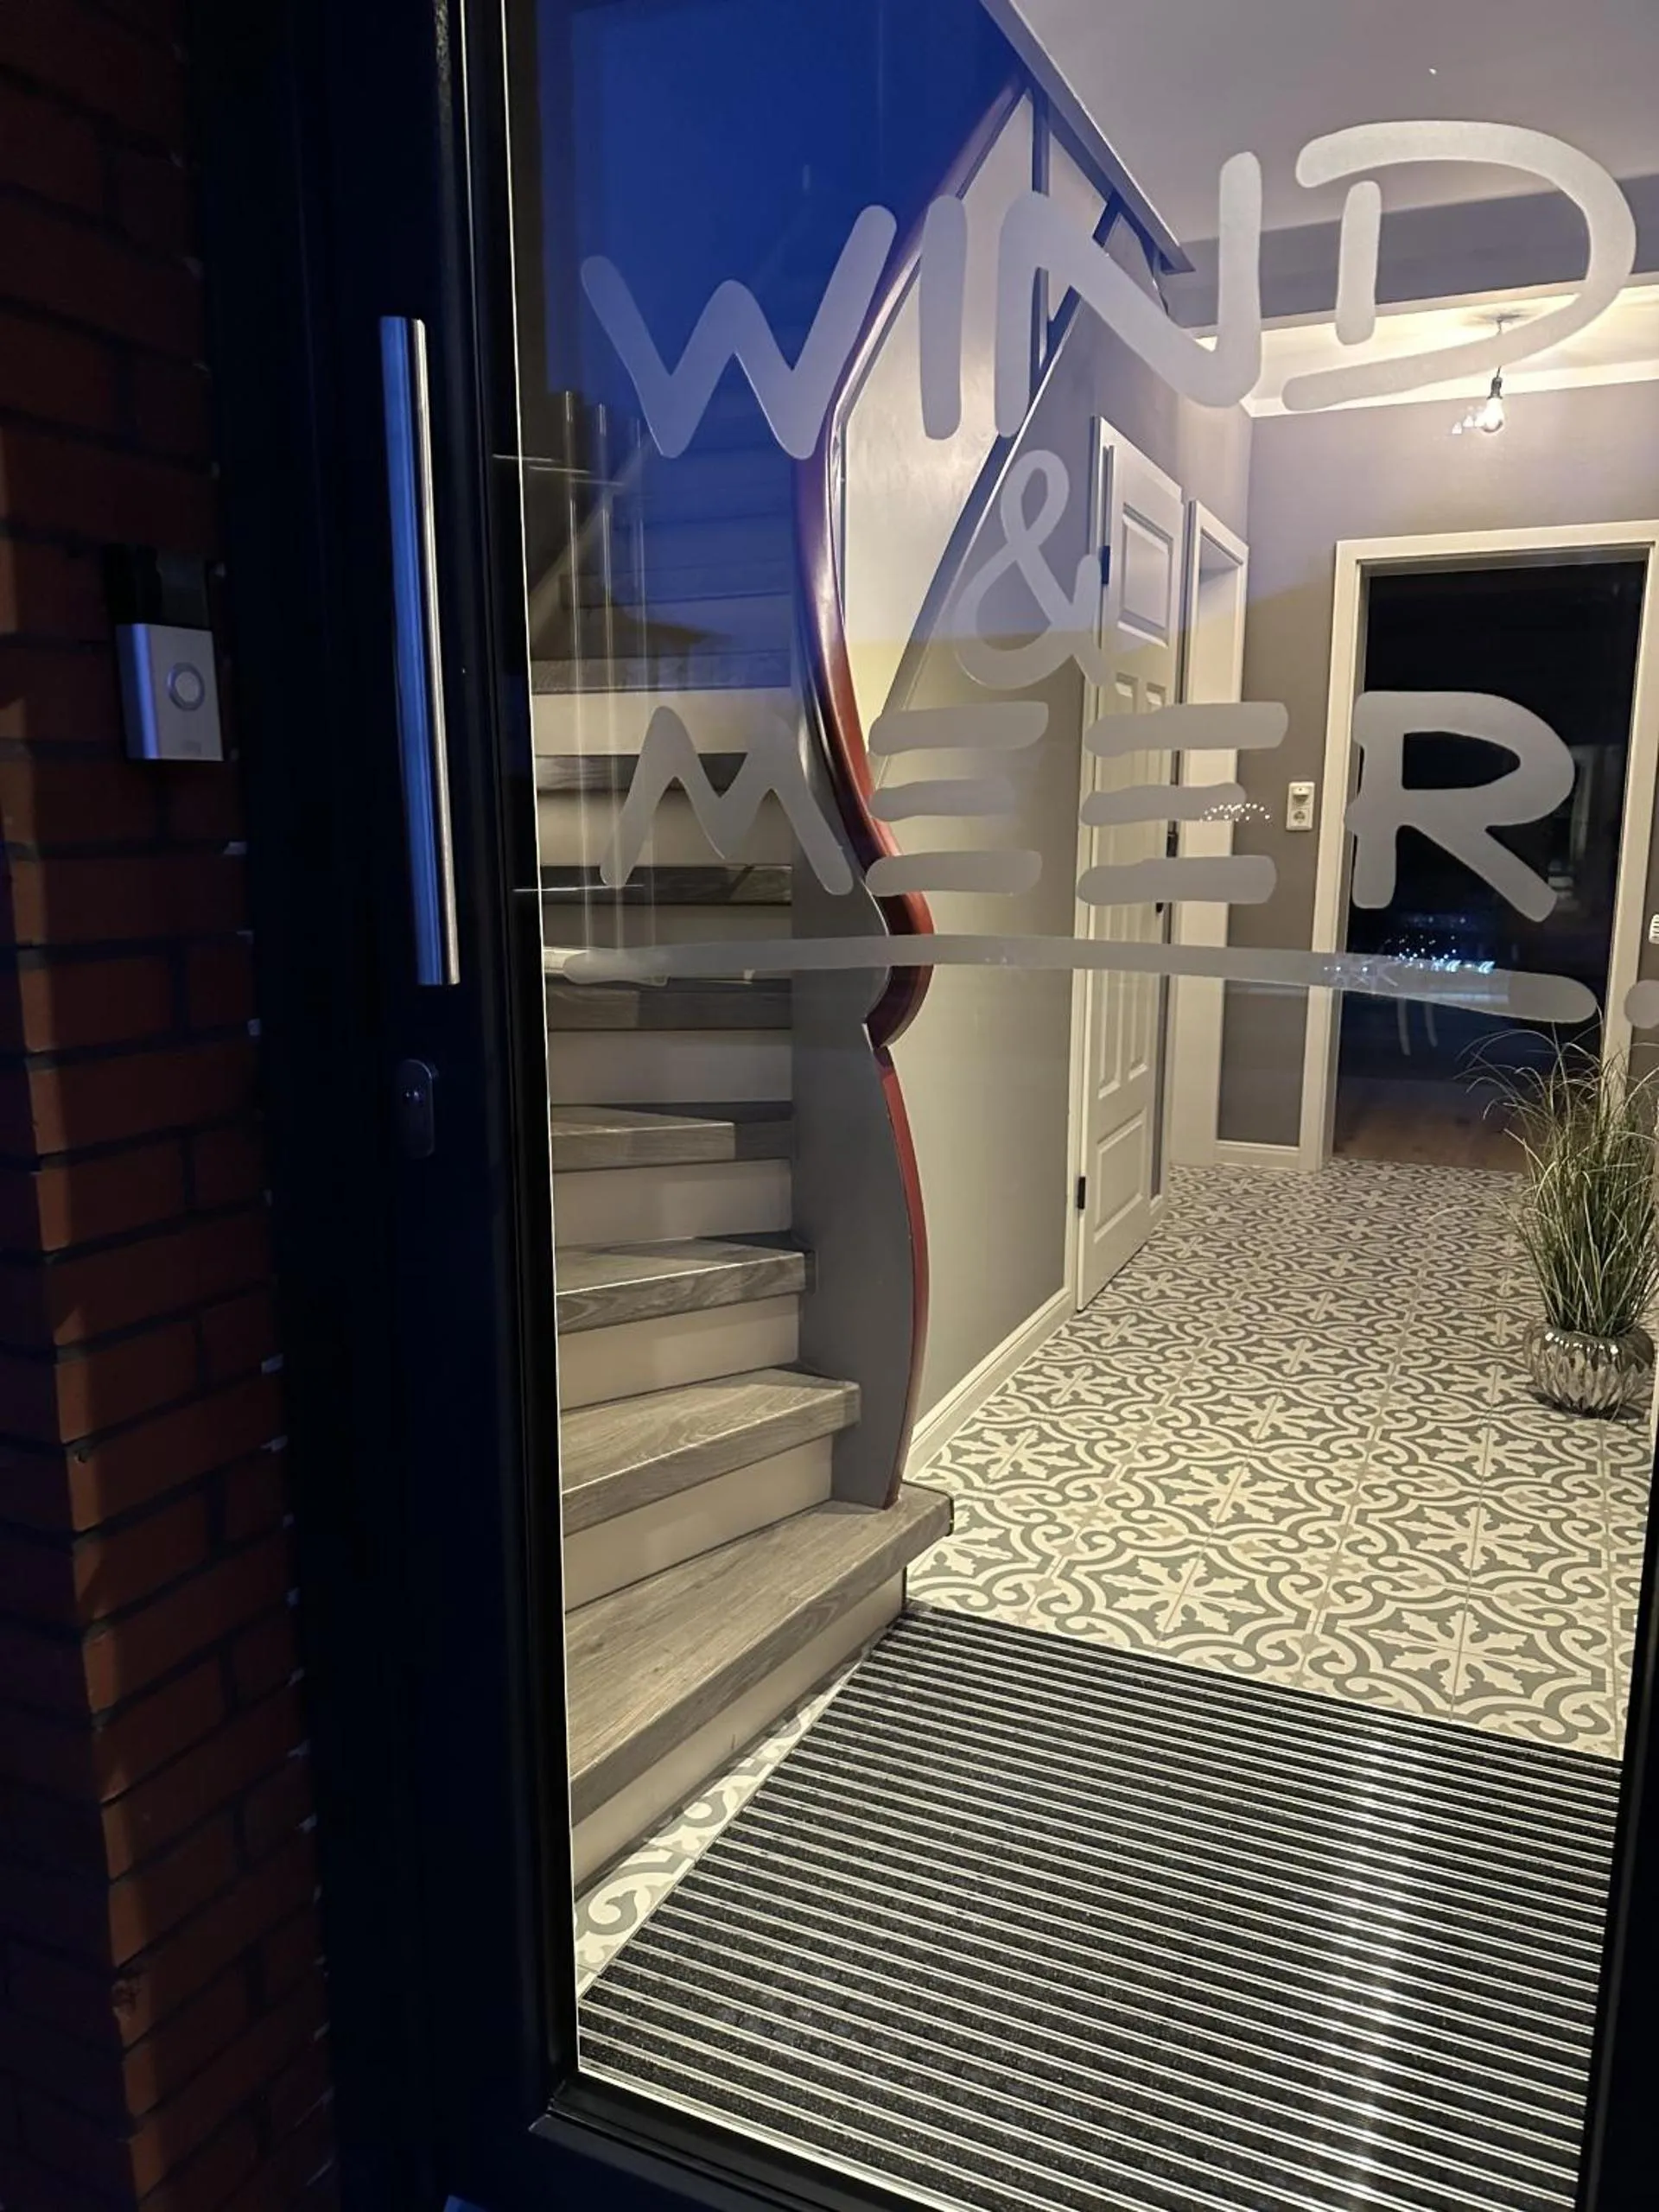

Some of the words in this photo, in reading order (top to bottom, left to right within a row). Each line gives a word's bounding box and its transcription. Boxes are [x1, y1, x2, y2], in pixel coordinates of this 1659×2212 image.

[581, 120, 1637, 460] WIND
[954, 449, 1116, 689] &
[600, 692, 1575, 922] MEER
